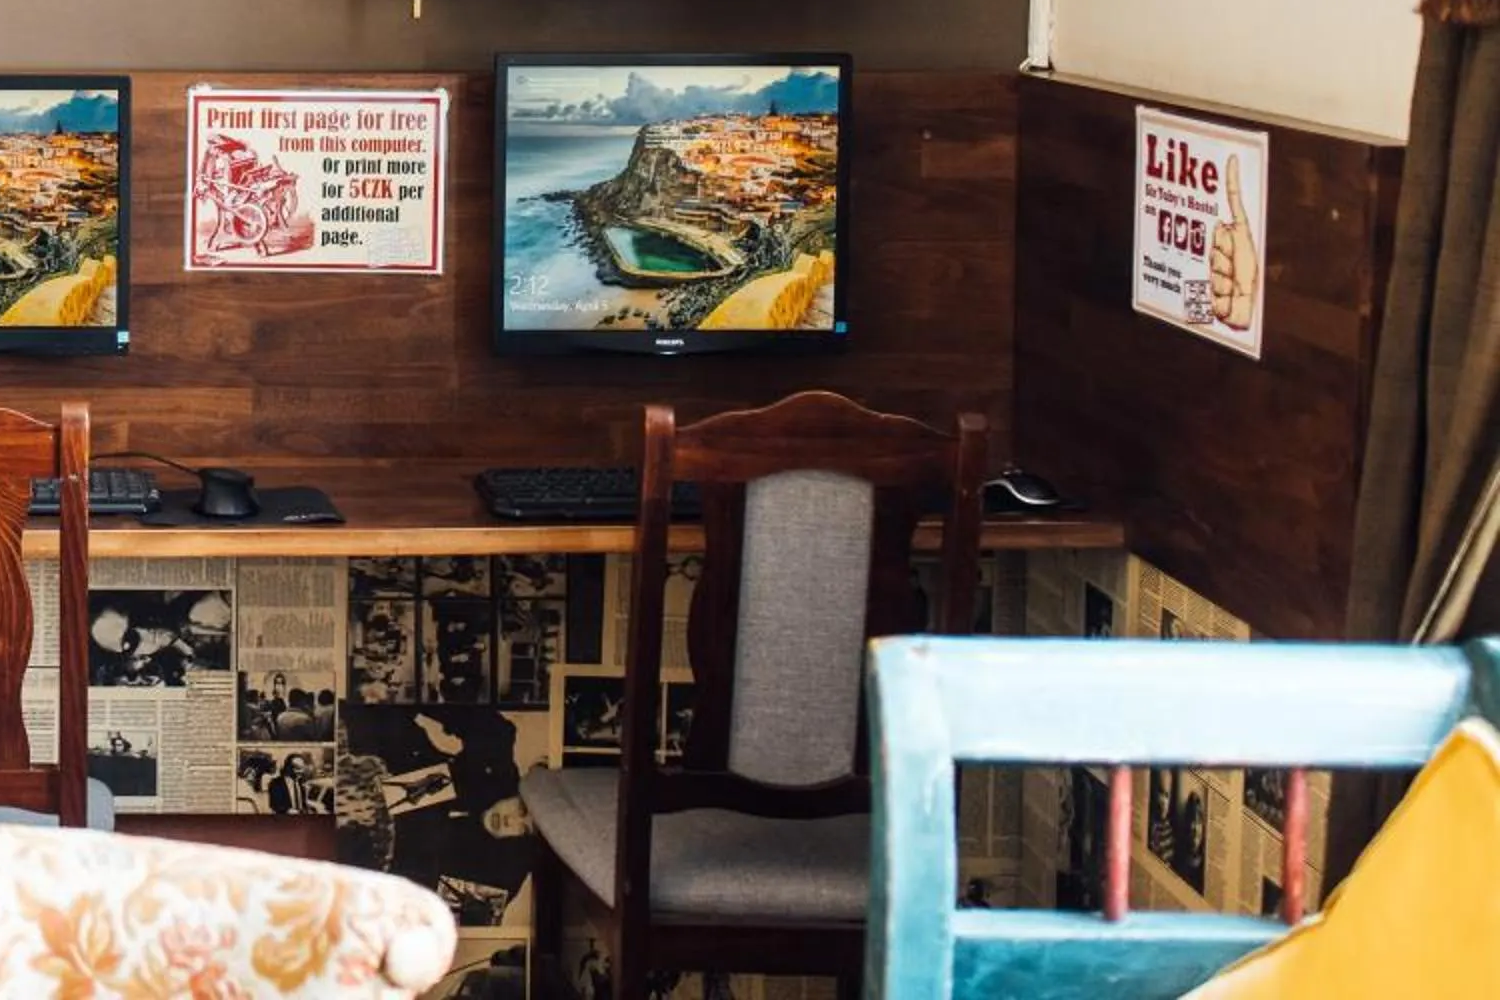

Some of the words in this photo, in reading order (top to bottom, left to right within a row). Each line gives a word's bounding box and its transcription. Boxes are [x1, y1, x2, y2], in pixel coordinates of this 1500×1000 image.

[207, 108, 253, 129] Print
[260, 108, 297, 130] first
[303, 110, 350, 132] page
[357, 109, 384, 130] for
[390, 109, 428, 130] free
[279, 135, 314, 152] from
[319, 135, 347, 152] this
[351, 137, 426, 155] computer.
[322, 158, 339, 174] Or
[345, 158, 382, 176] print
[387, 160, 426, 174] more
[1145, 133, 1219, 194] Like
[321, 182, 343, 199] for
[349, 178, 393, 199] 5CZK
[399, 183, 424, 201] per
[321, 205, 400, 222] additional
[321, 229, 363, 247] page.
[509, 275, 549, 295] 2:12
